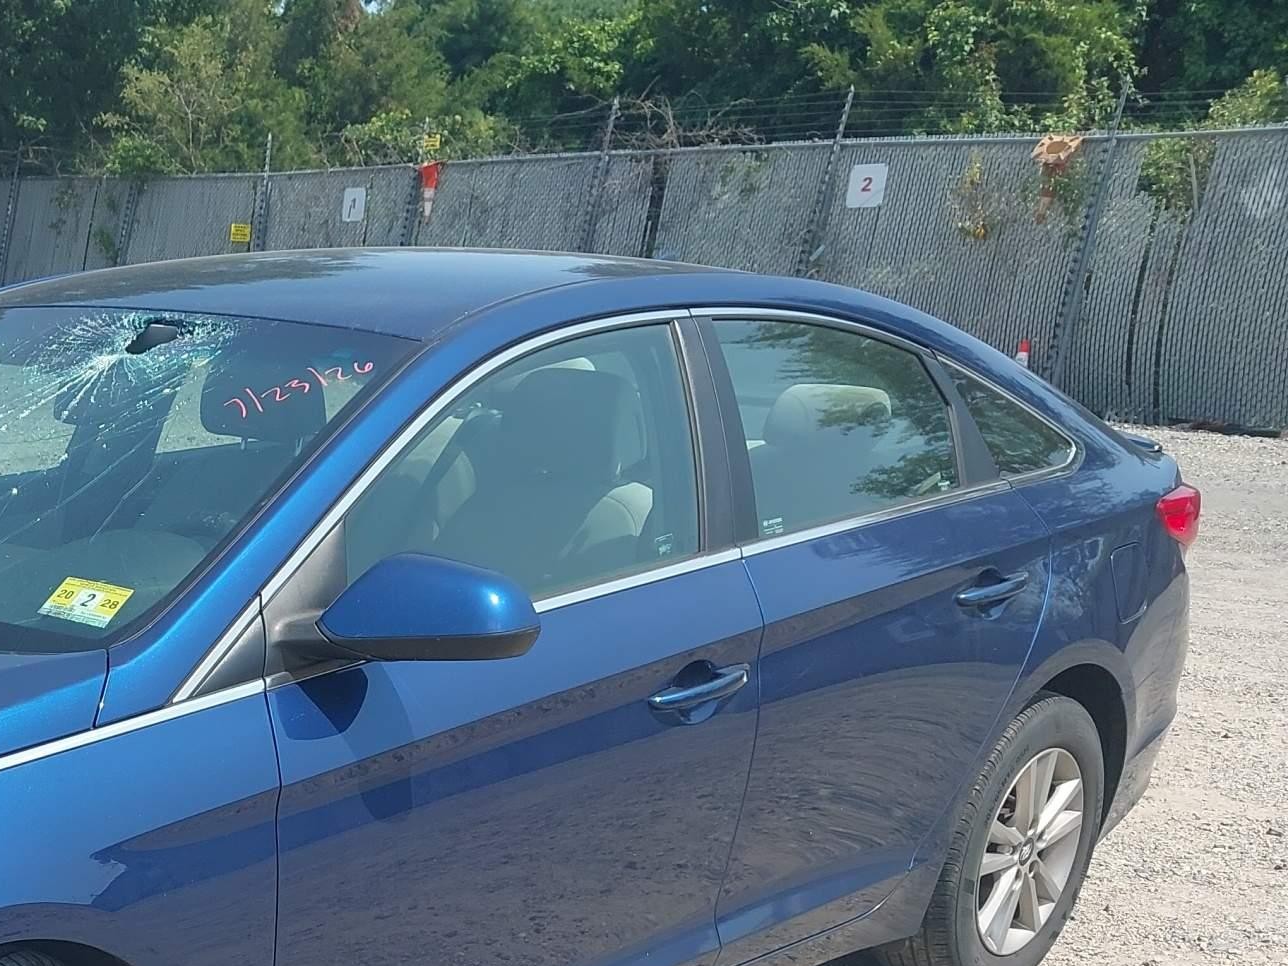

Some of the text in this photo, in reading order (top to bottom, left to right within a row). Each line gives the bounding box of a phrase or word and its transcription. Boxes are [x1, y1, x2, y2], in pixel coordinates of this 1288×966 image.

[860, 177, 873, 192] 2
[223, 361, 374, 418] 7/23/26
[57, 589, 120, 610] 20 2 28
